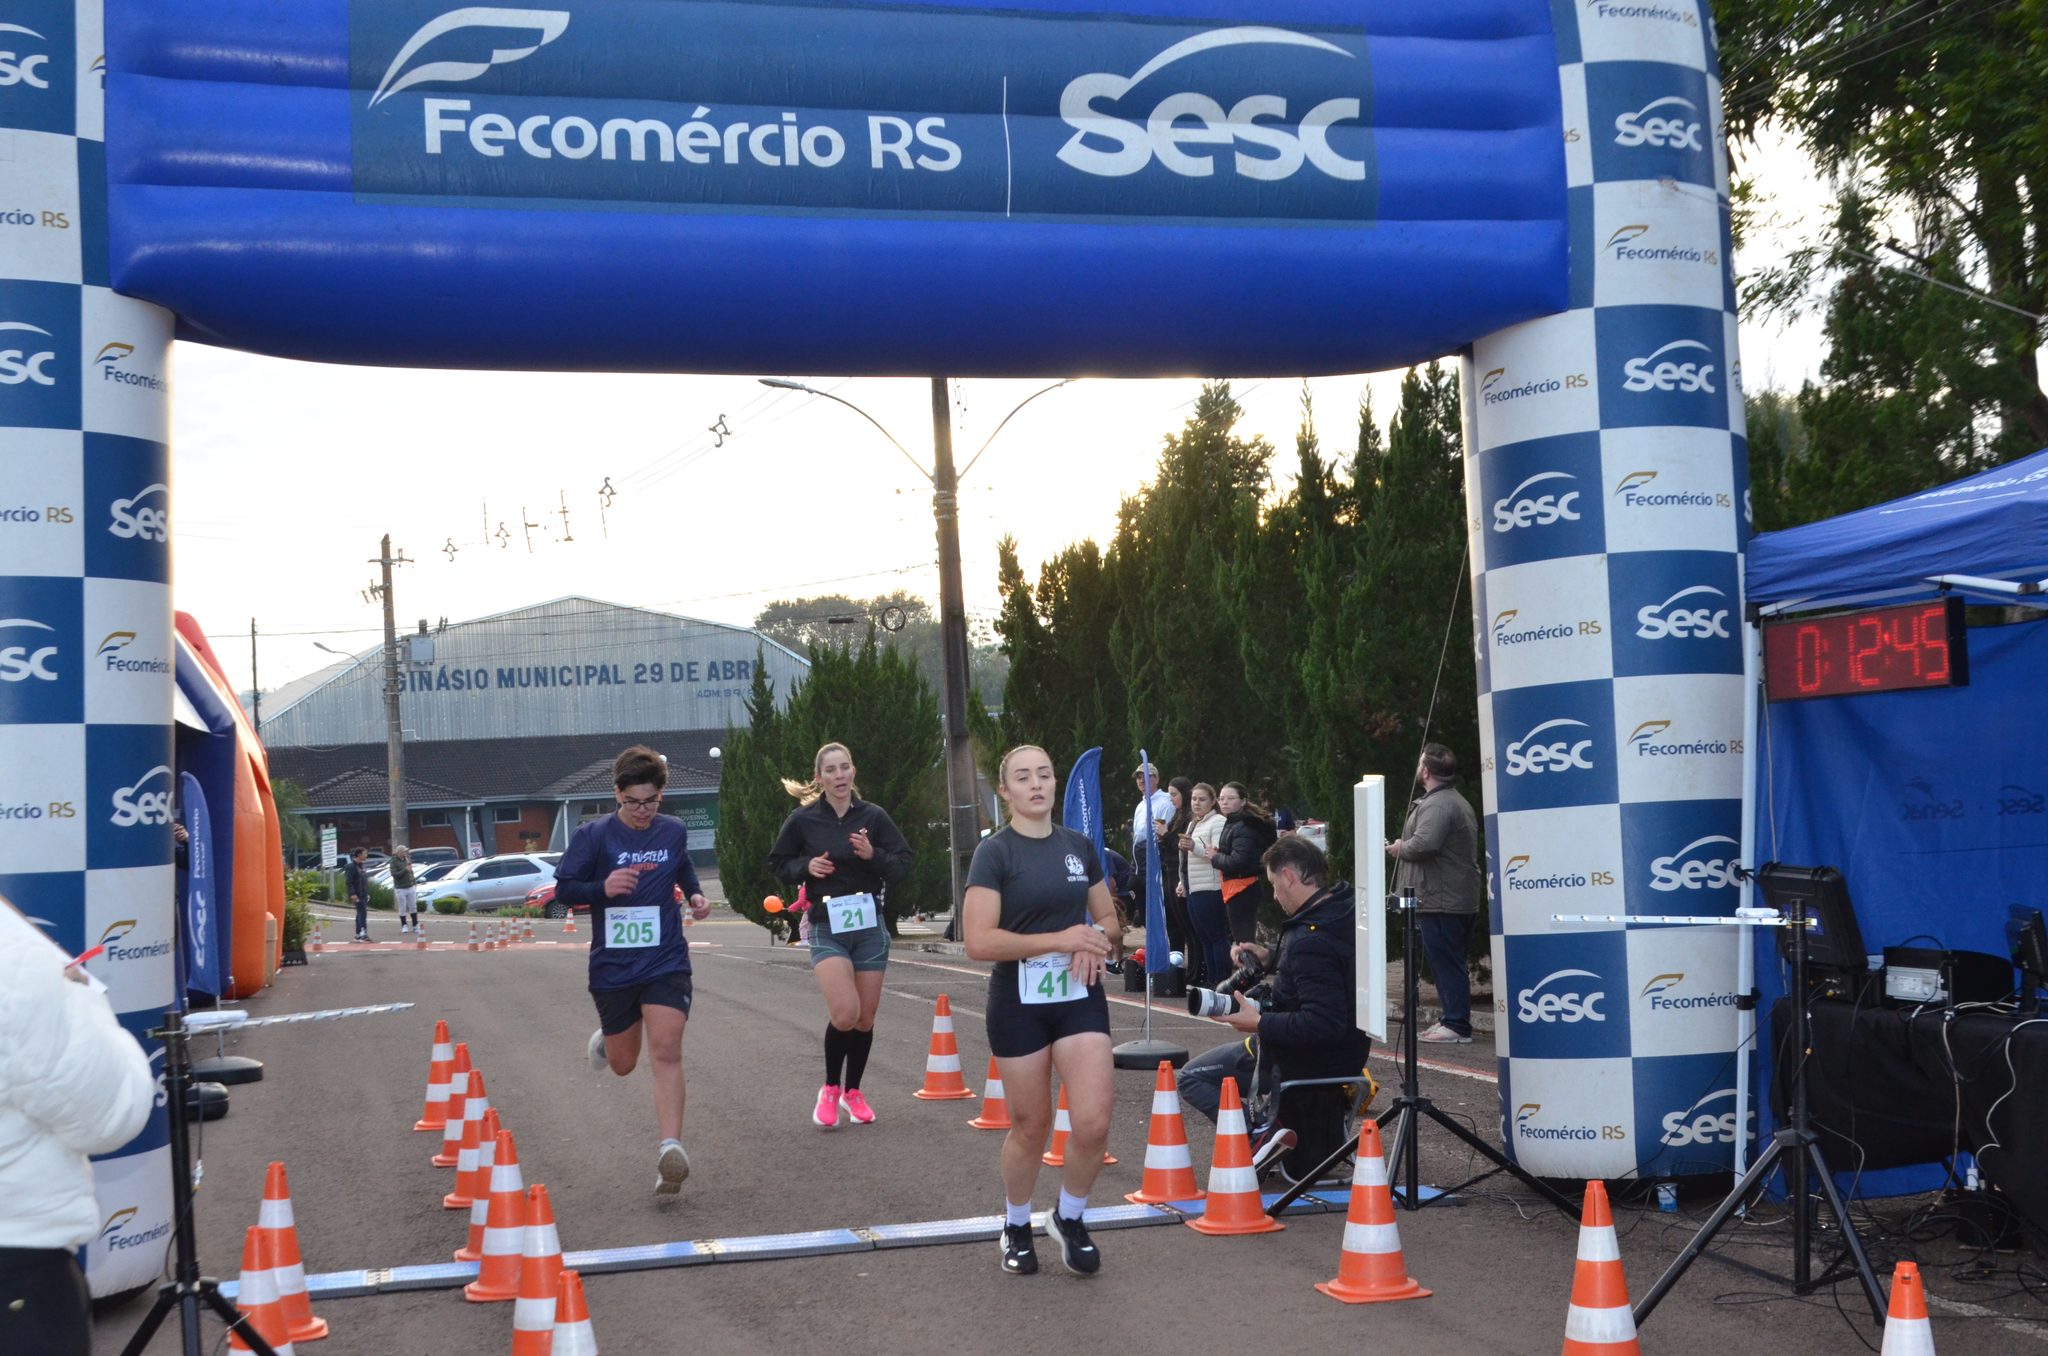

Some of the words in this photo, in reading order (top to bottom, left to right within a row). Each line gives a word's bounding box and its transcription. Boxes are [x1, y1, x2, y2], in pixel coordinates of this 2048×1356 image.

[424, 98, 846, 168] Fecomércio
[868, 115, 962, 172] RS
[1055, 26, 1366, 181] Sesc
[1614, 96, 1703, 152] Sesc
[42, 211, 70, 229] RS
[1616, 246, 1701, 262] Fecomércio
[1704, 250, 1718, 266] RS
[1622, 339, 1716, 394] Sesc
[1485, 378, 1561, 406] Fecomércio
[1565, 373, 1589, 389] RS
[1493, 472, 1581, 532] Sesc
[1625, 491, 1713, 507] Fecomércio
[1716, 493, 1731, 508] RS
[46, 507, 74, 524] RS
[1636, 585, 1730, 640] Sesc
[1497, 625, 1574, 647] Fecomércio
[1578, 620, 1602, 636] RS
[1797, 607, 1950, 693] 0:12:45
[497, 664, 627, 689] MUNICIPAL
[634, 662, 664, 684] 29
[670, 661, 700, 682] DE
[1505, 719, 1594, 776] Sesc
[1638, 740, 1728, 757] Fecomércio
[1730, 739, 1744, 754] RS
[48, 802, 76, 819] RS
[1079, 778, 1090, 836] ecomércio
[1509, 873, 1586, 890] Fecomércio
[1591, 871, 1615, 887] RS
[612, 921, 654, 944] 205
[842, 908, 864, 929] 21
[1037, 970, 1068, 998] 41
[1518, 969, 1606, 1024] Sesc
[1520, 1125, 1597, 1140] Fecomércio
[1602, 1125, 1626, 1140] RS
